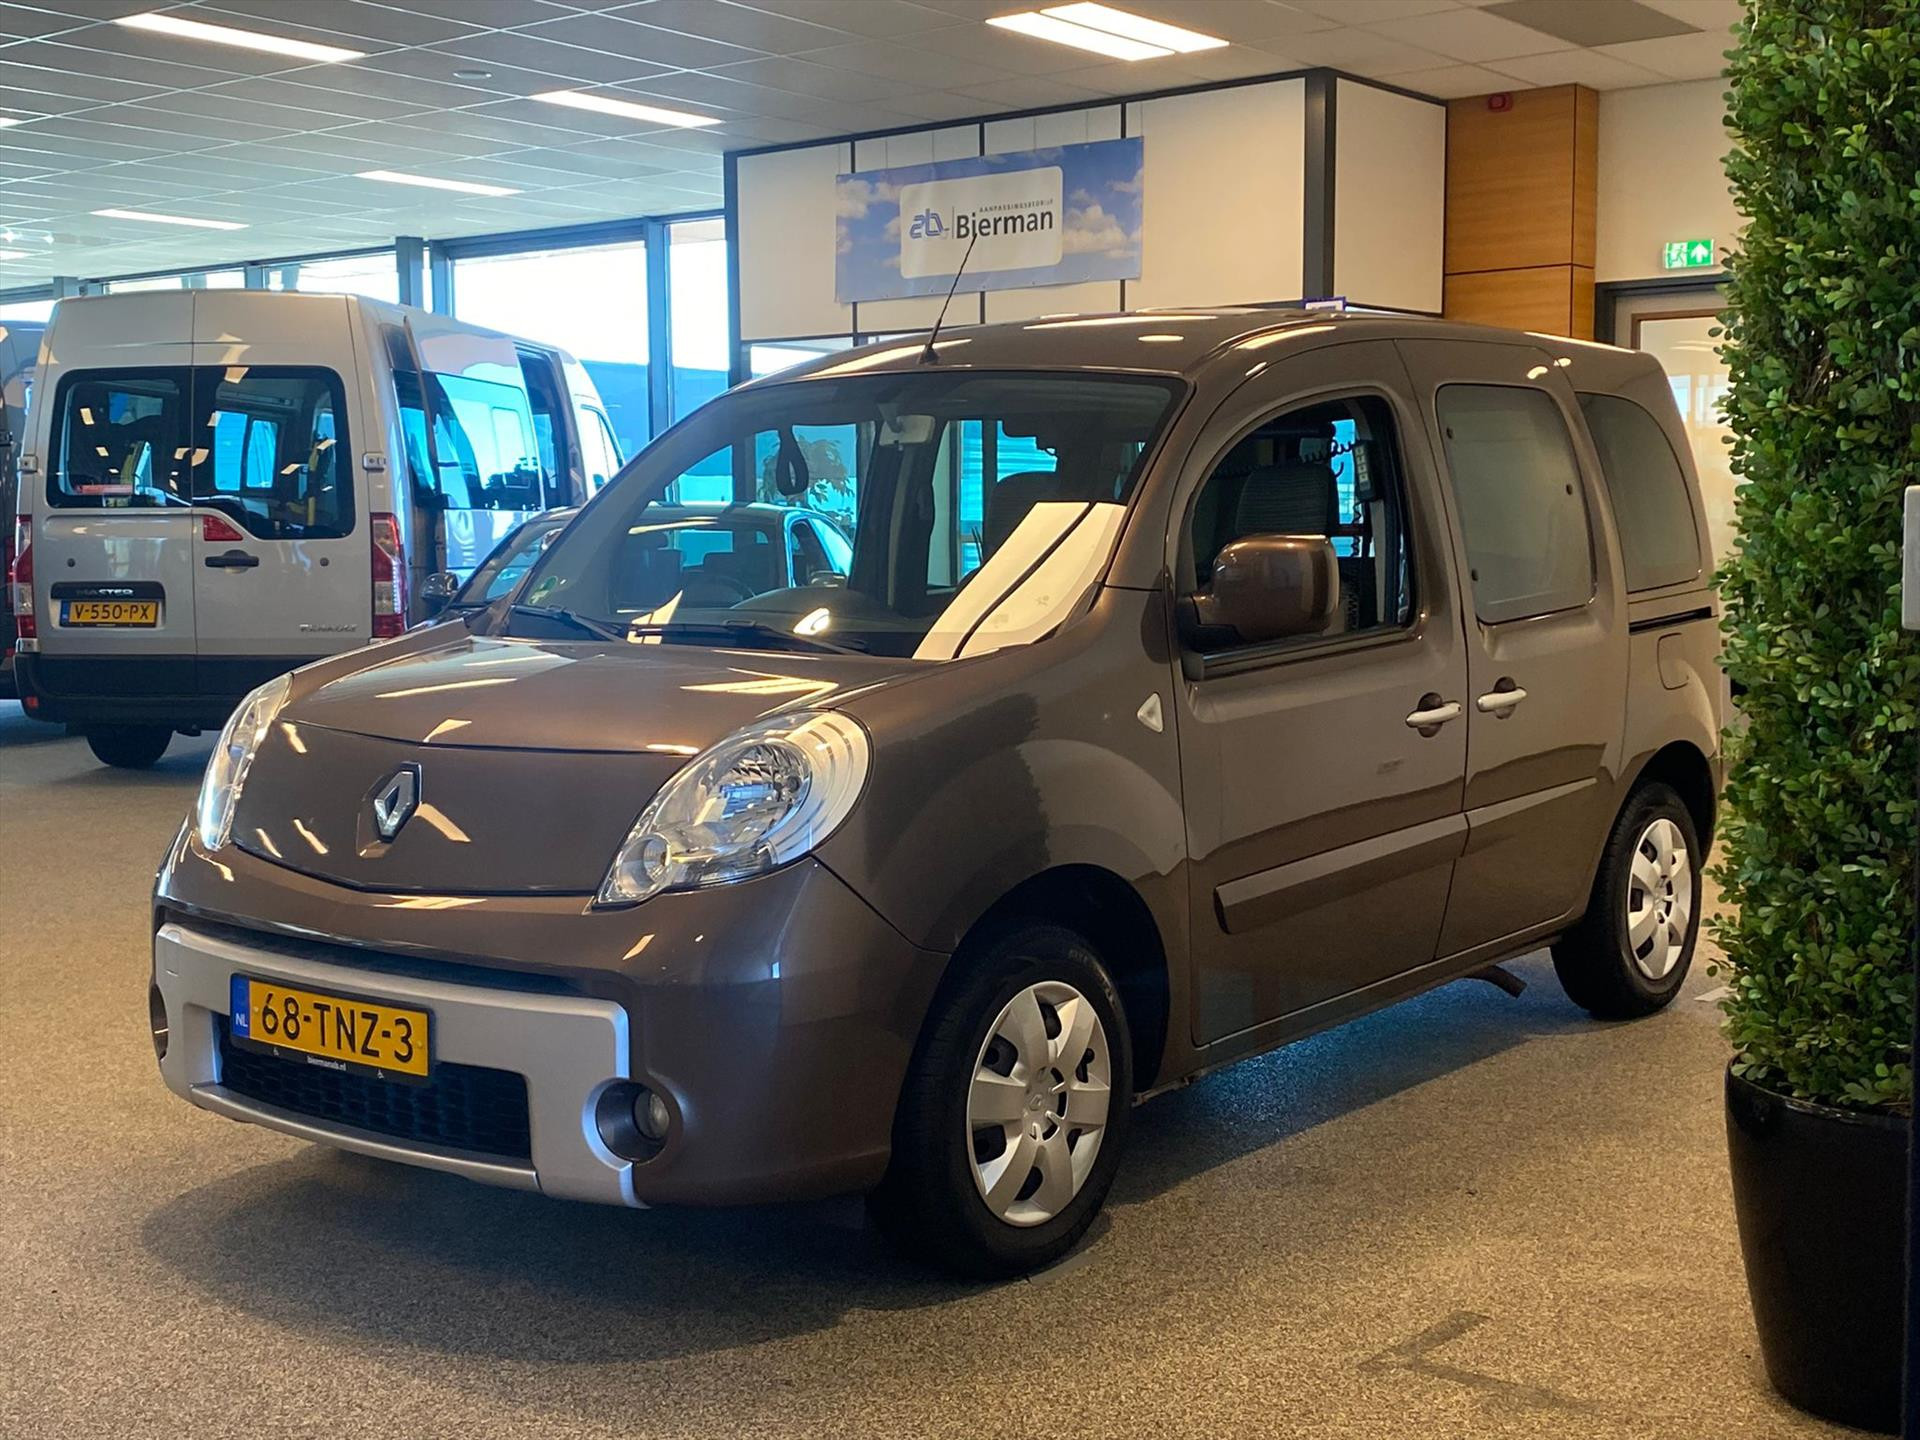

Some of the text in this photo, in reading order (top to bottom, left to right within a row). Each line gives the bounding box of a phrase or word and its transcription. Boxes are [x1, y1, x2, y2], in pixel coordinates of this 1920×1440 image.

[957, 210, 1053, 239] Bierman
[75, 604, 150, 620] V-550-PX
[235, 1012, 249, 1028] NL
[261, 993, 414, 1063] 68-TNZ-3
